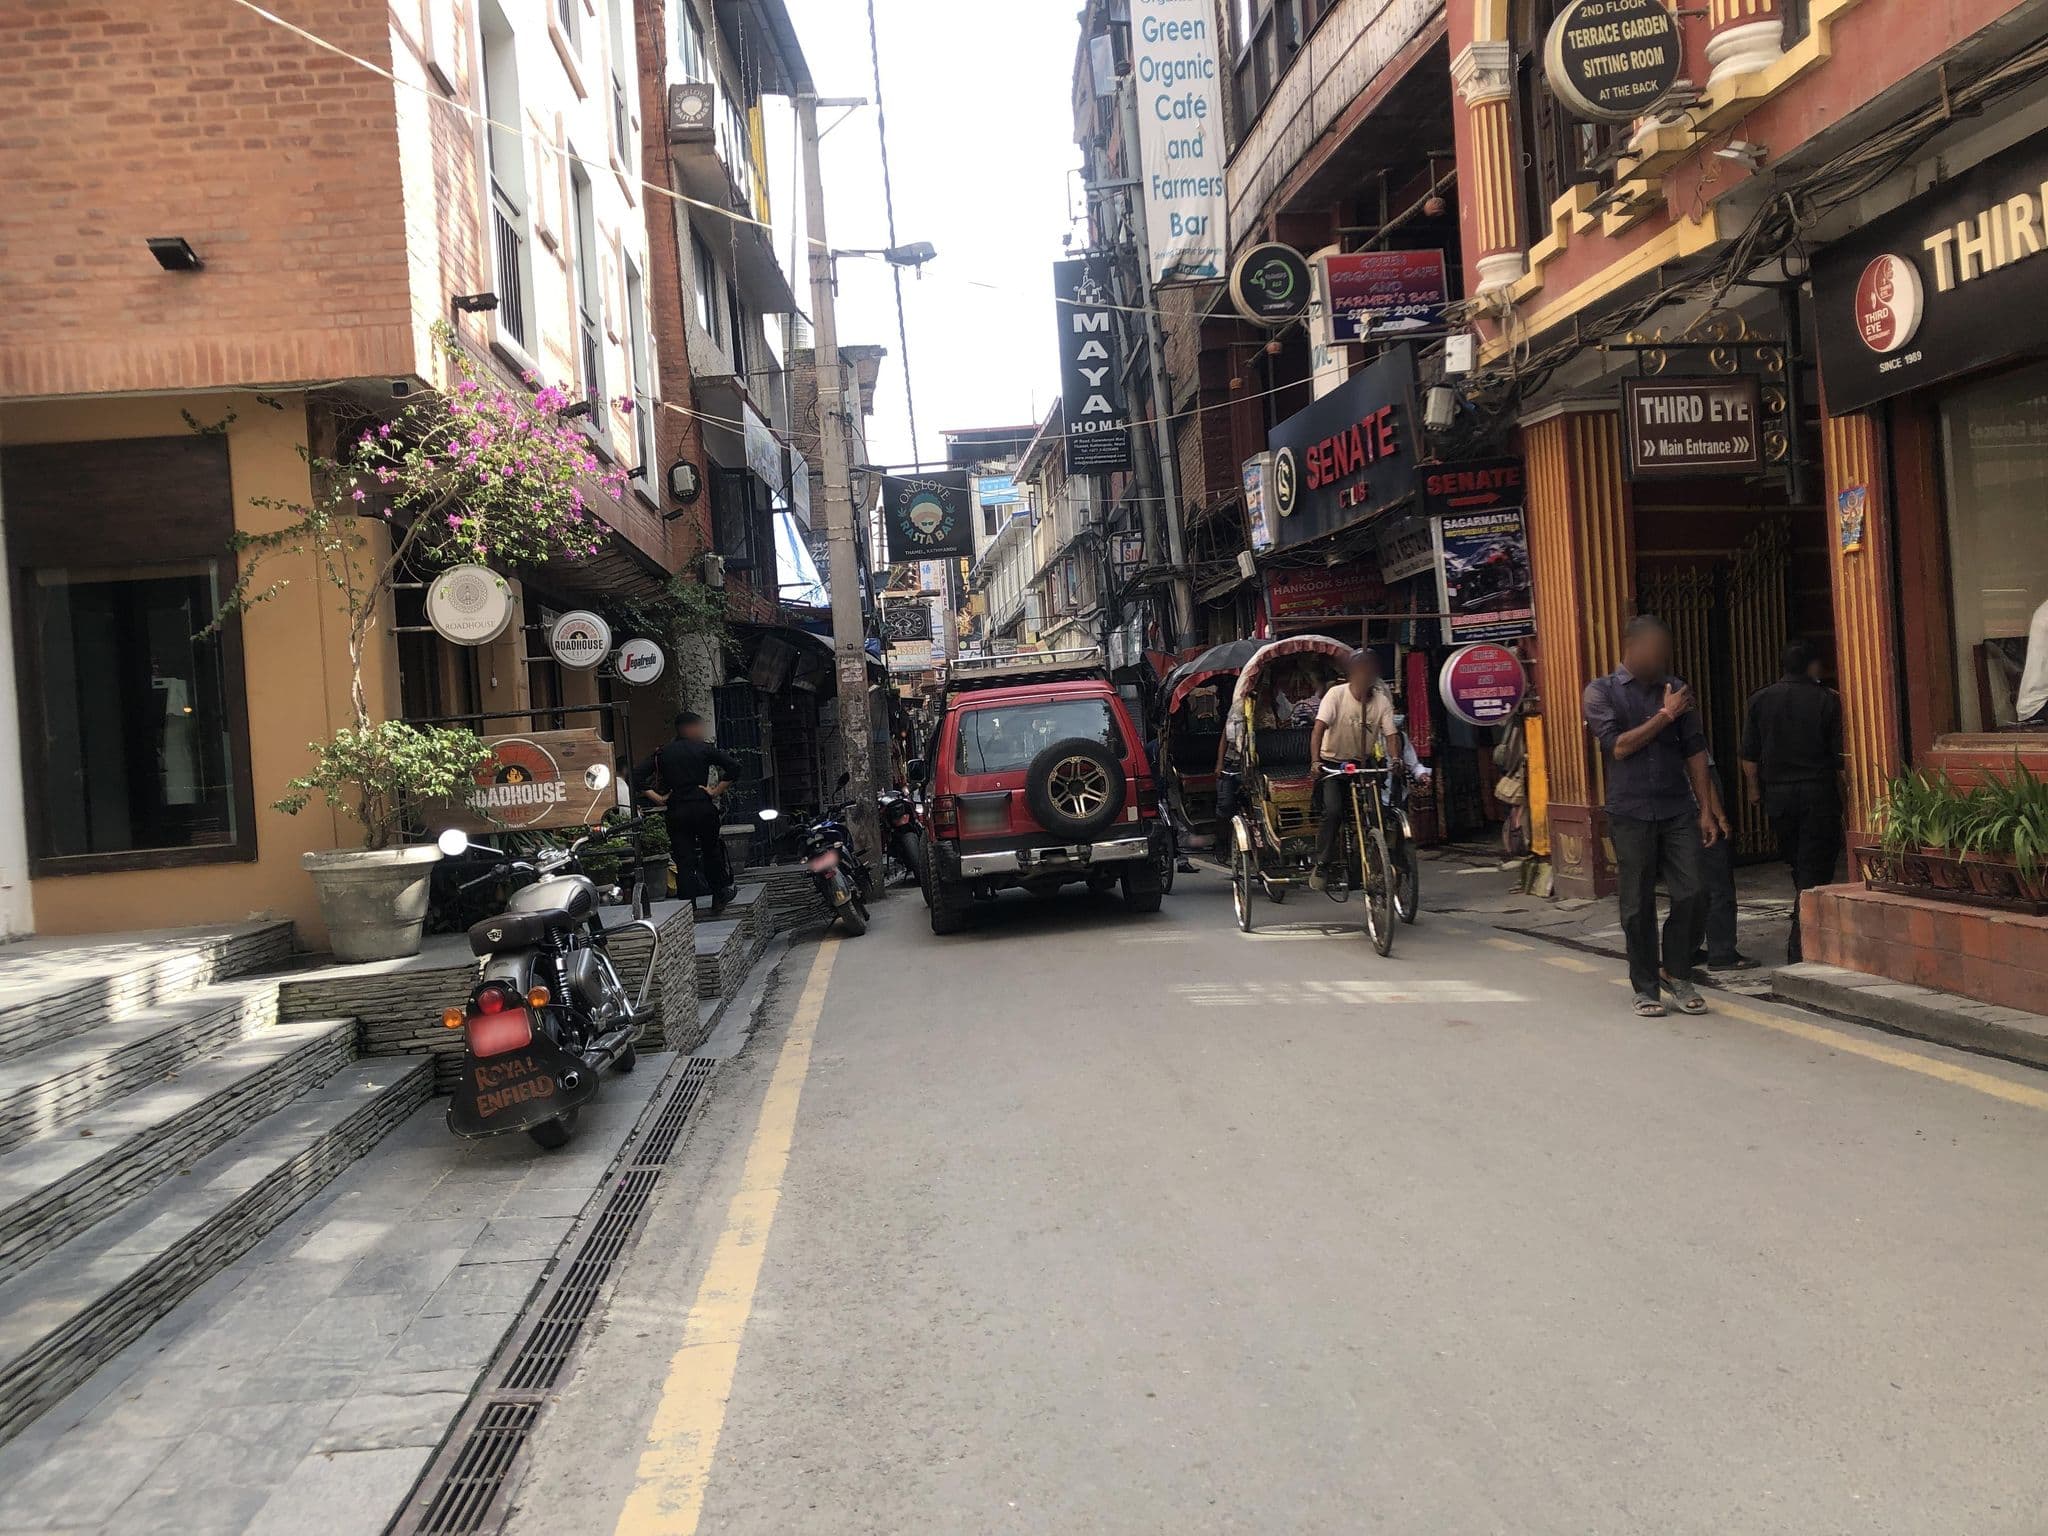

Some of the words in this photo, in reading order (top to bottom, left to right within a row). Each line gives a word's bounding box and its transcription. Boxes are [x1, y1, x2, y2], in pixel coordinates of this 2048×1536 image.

[1582, 3, 1604, 17] 2ND
[1142, 15, 1205, 43] Green
[1568, 22, 1621, 49] TERRACE
[1621, 14, 1669, 41] GARDEN
[1139, 51, 1215, 88] Organic
[1583, 52, 1629, 78] SITTING
[1630, 46, 1665, 69] ROOM
[1599, 87, 1611, 100] AT
[1614, 84, 1631, 98] THE
[1632, 79, 1659, 95] BACK
[1155, 91, 1208, 121] Café
[1168, 131, 1204, 159] and
[1152, 173, 1224, 200] Farmers
[1170, 211, 1208, 237] Bar
[1923, 180, 2048, 292] THIR
[1394, 303, 1430, 317] 2004
[1864, 307, 1889, 324] THIRD
[1866, 322, 1883, 336] EYE
[1073, 311, 1113, 415] MAYA
[1879, 358, 1902, 374] SINCE
[1904, 350, 1923, 366] 1989
[1640, 395, 1704, 425] THIRD
[1710, 396, 1749, 422] EYE
[1071, 420, 1124, 434] HOME
[1306, 404, 1395, 490] SENATE
[1659, 438, 1684, 456] Main
[1686, 437, 1731, 455] Entrance
[1427, 467, 1521, 497] SENATE
[901, 520, 934, 545] RASTA
[935, 516, 955, 542] BAR
[1443, 513, 1520, 530] SAGARMATHA
[1273, 581, 1334, 596] HANKOOK
[445, 620, 496, 632] ROADHOUSE
[555, 639, 604, 651] ROADHOUSE
[475, 1056, 538, 1091] ROYAL
